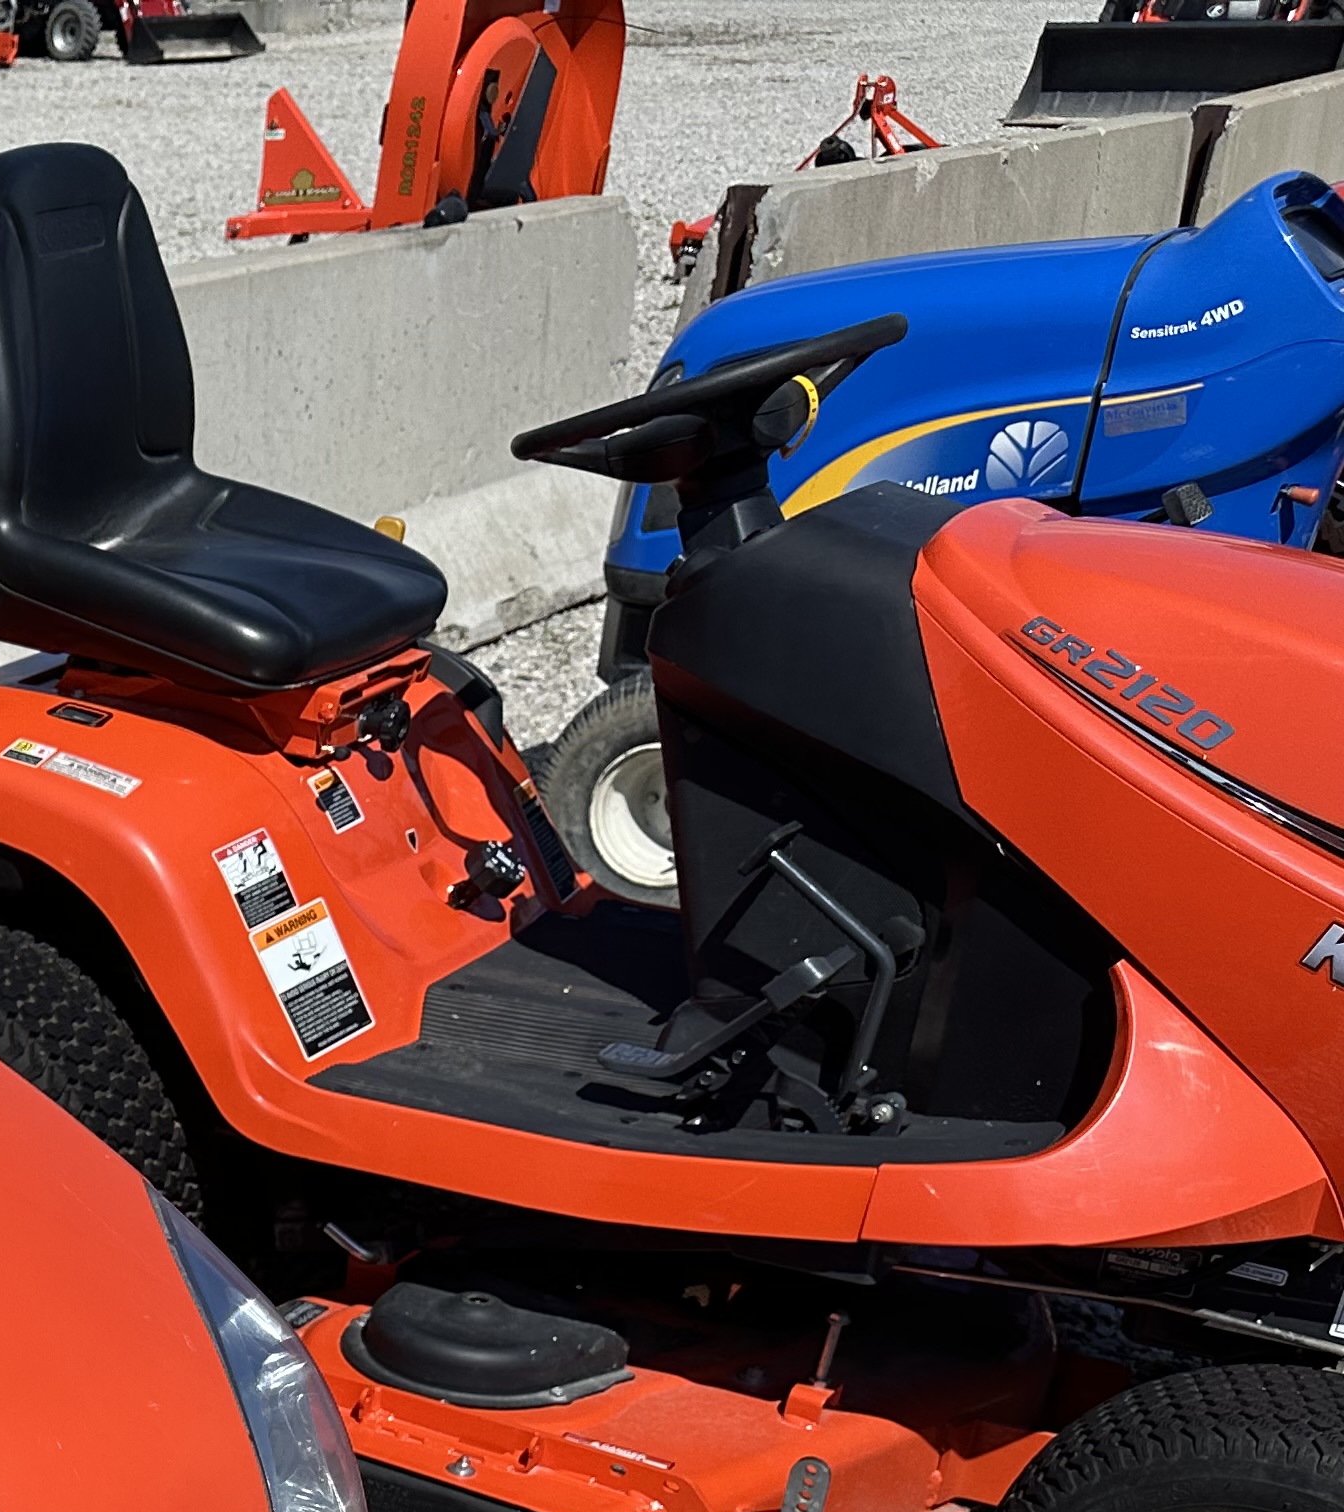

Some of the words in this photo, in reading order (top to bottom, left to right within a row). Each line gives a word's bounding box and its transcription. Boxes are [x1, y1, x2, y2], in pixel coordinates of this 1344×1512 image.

[1130, 320, 1198, 340] Sensitrak
[1200, 299, 1245, 327] 4WD
[898, 468, 980, 496] olland
[1019, 615, 1237, 751] GR2120
[273, 908, 318, 938] WARNING
